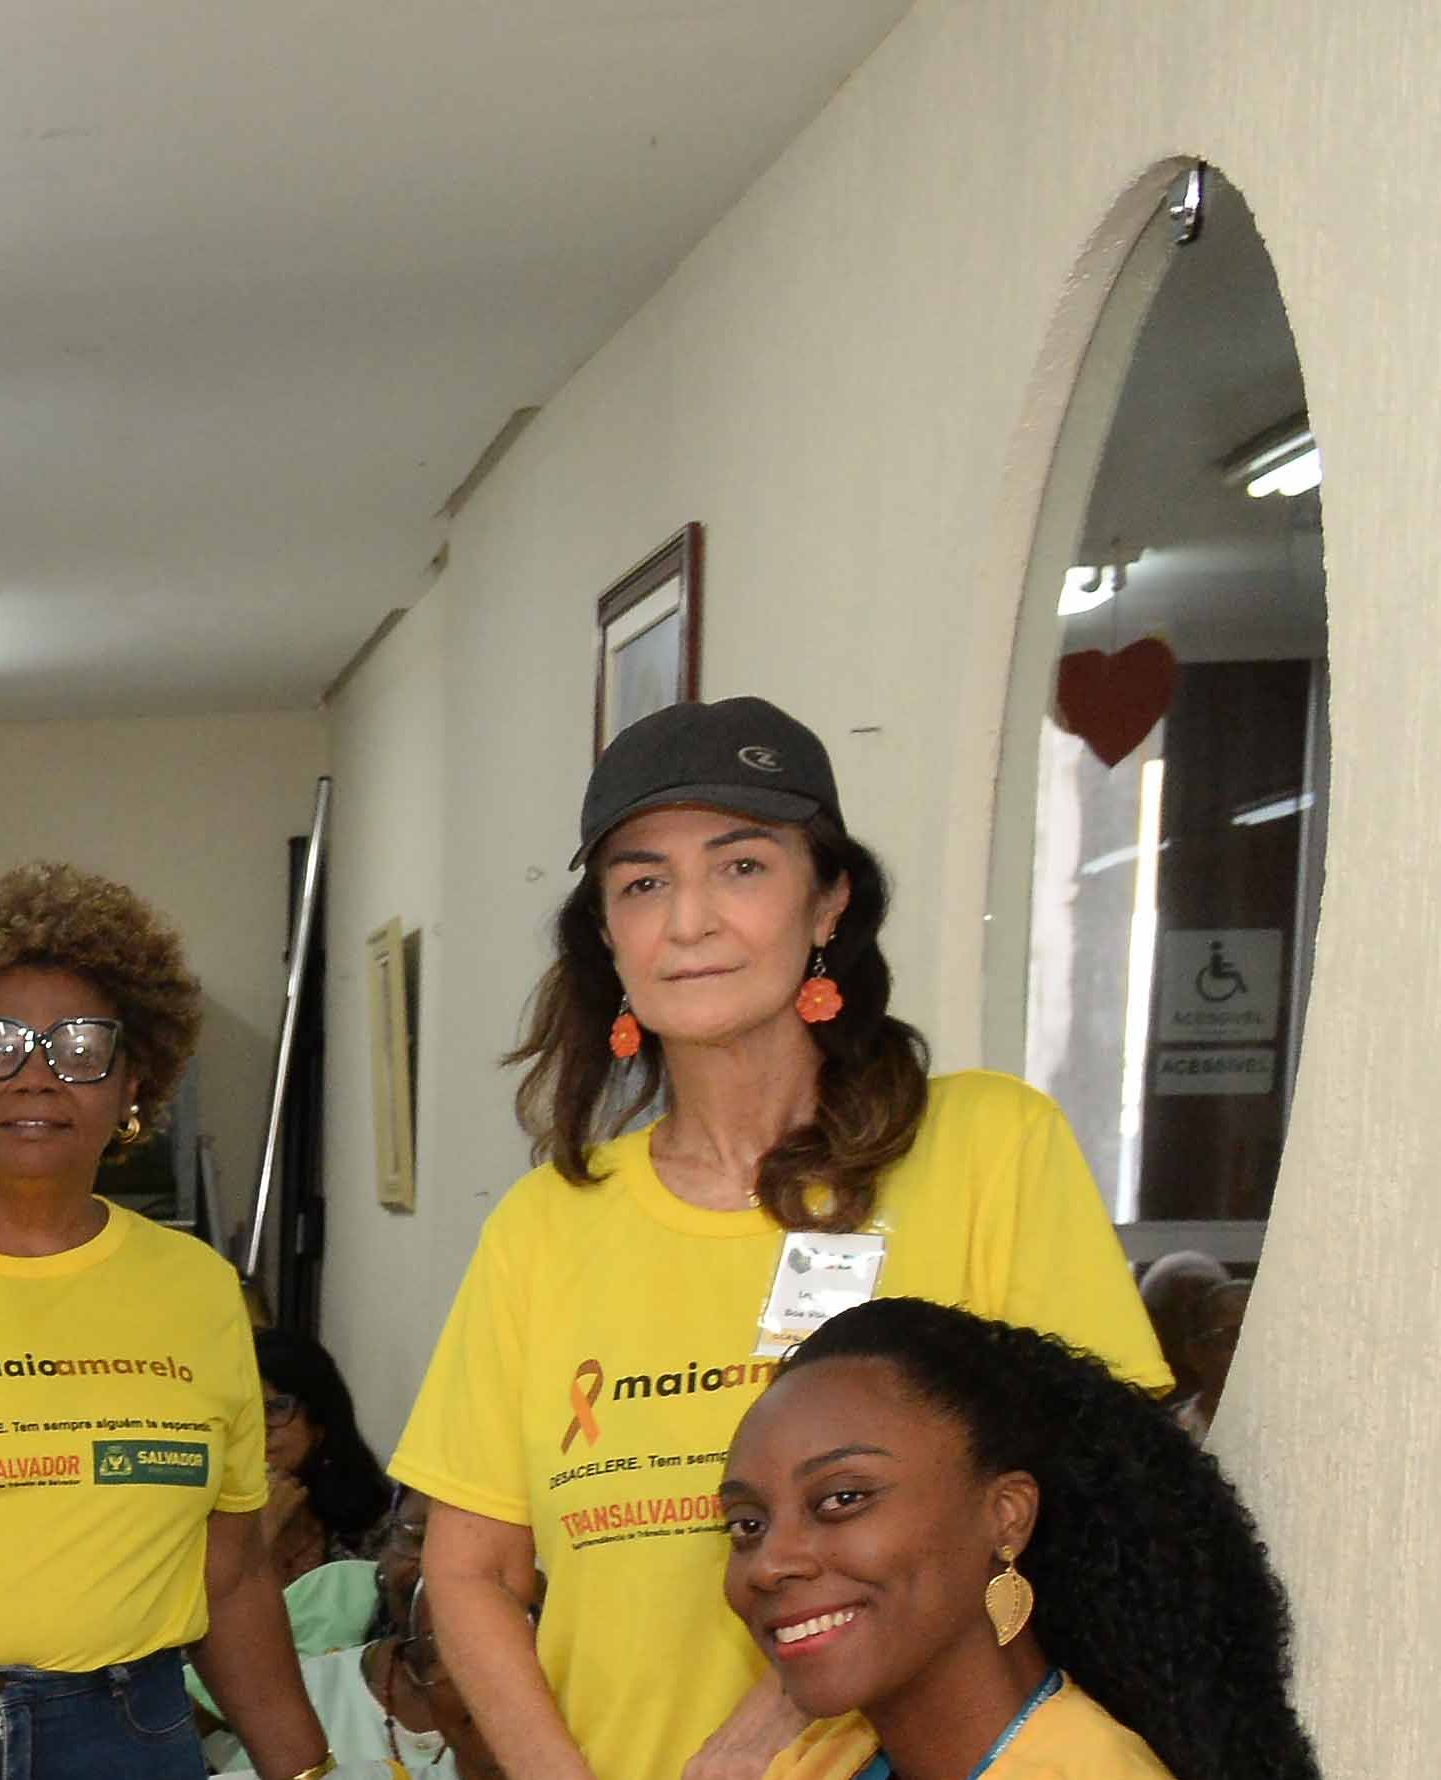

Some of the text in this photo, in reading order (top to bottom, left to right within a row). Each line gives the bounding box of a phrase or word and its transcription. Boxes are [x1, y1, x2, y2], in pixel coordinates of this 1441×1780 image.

[12, 1421, 39, 1432] Tem
[43, 1421, 92, 1432] sempre
[137, 1451, 203, 1467] SALVADOR
[648, 1454, 681, 1467] Tem
